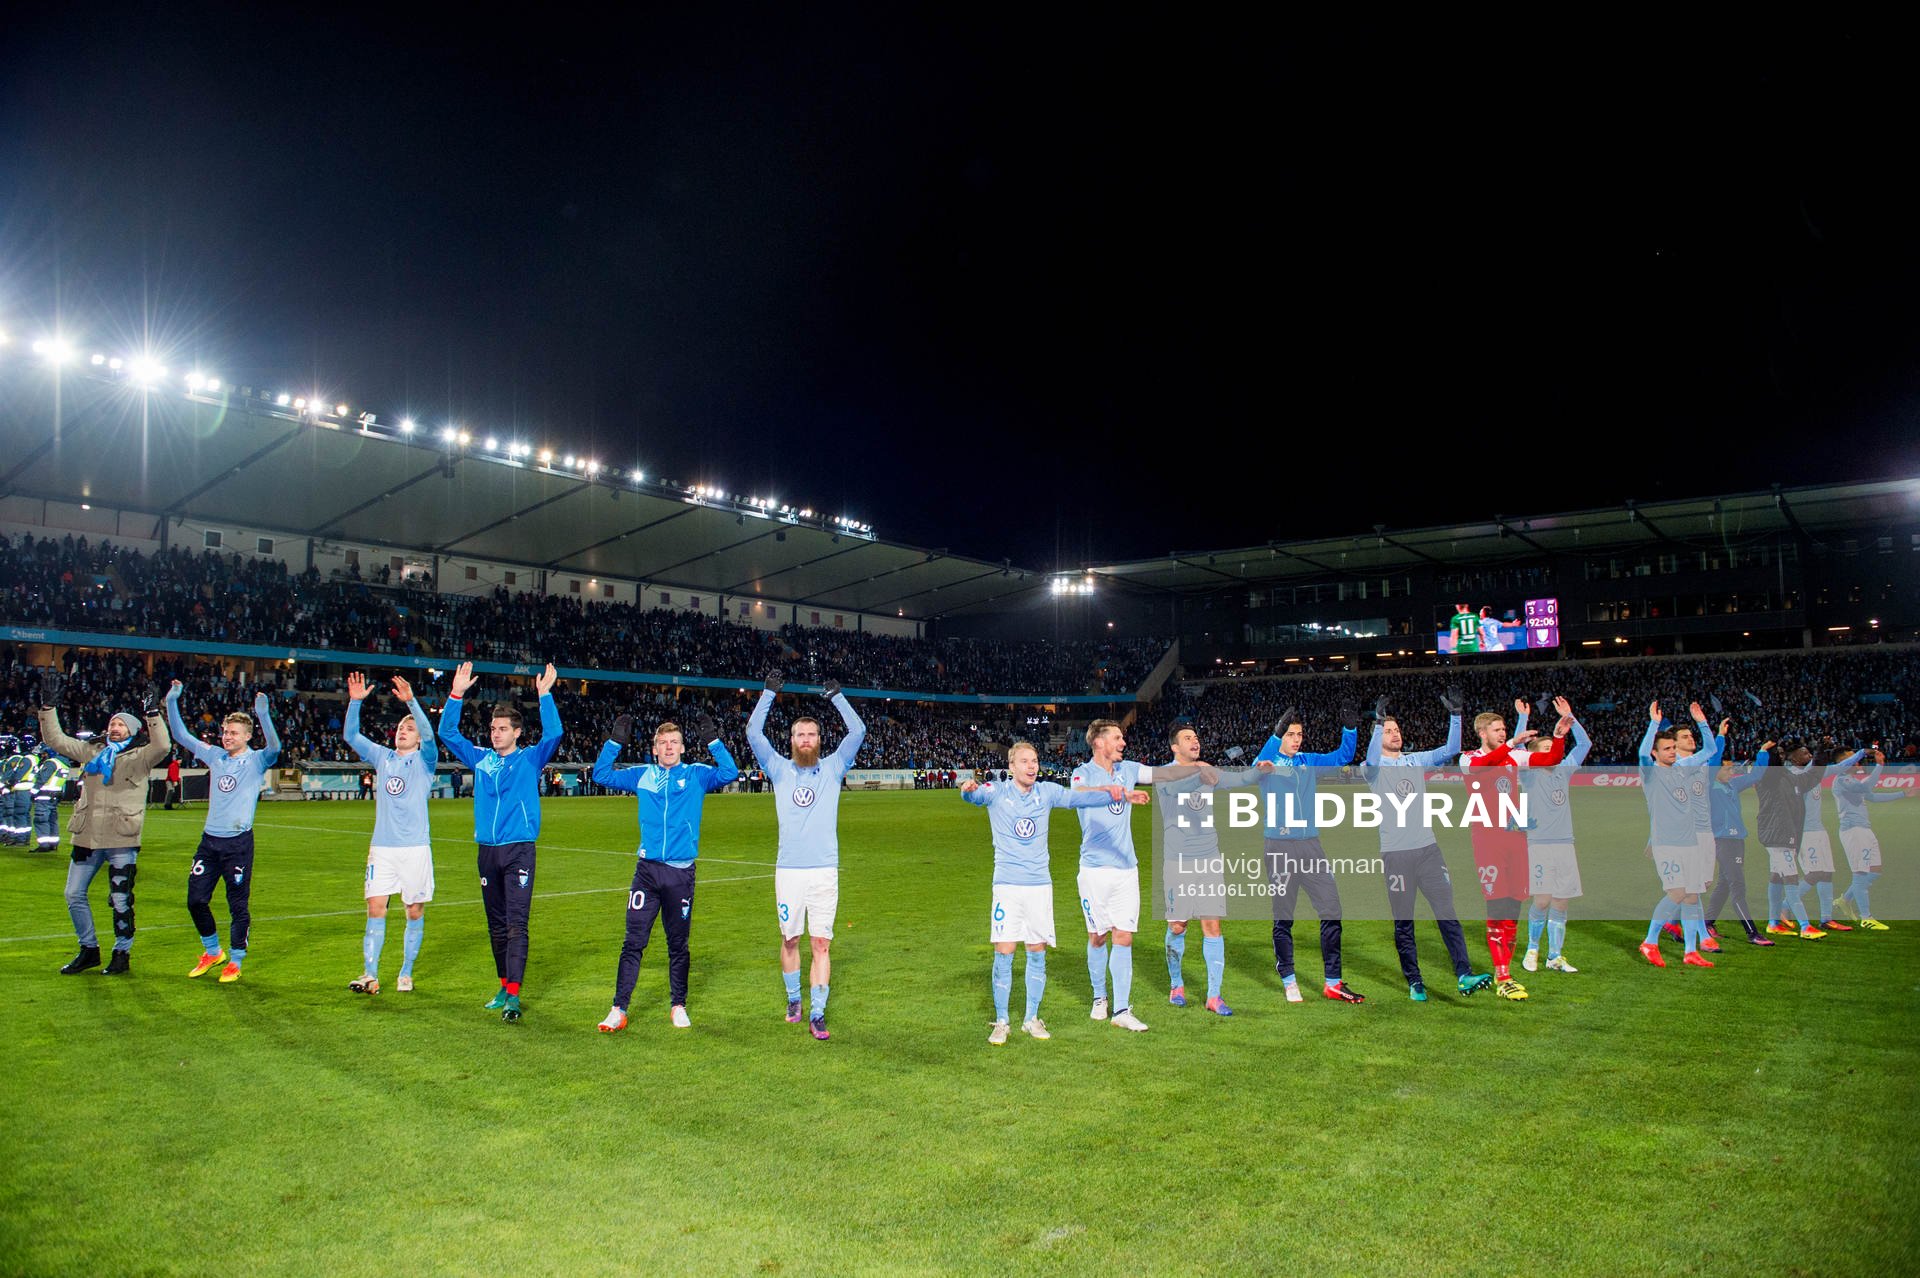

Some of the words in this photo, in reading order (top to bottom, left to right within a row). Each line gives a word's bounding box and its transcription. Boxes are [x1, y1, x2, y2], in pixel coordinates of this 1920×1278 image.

[1529, 607, 1535, 615] 3
[1547, 605, 1555, 614] 0
[1460, 619, 1475, 635] 11
[1529, 617, 1555, 627] 92:06
[1279, 827, 1291, 835] 24
[1807, 847, 1817, 859] 2
[1478, 865, 1498, 884] 29
[1535, 864, 1544, 879] 3
[1663, 861, 1681, 875] 26
[1271, 872, 1292, 890] 37
[1389, 874, 1406, 892] 21
[628, 890, 646, 910] 10
[994, 902, 1006, 922] 6
